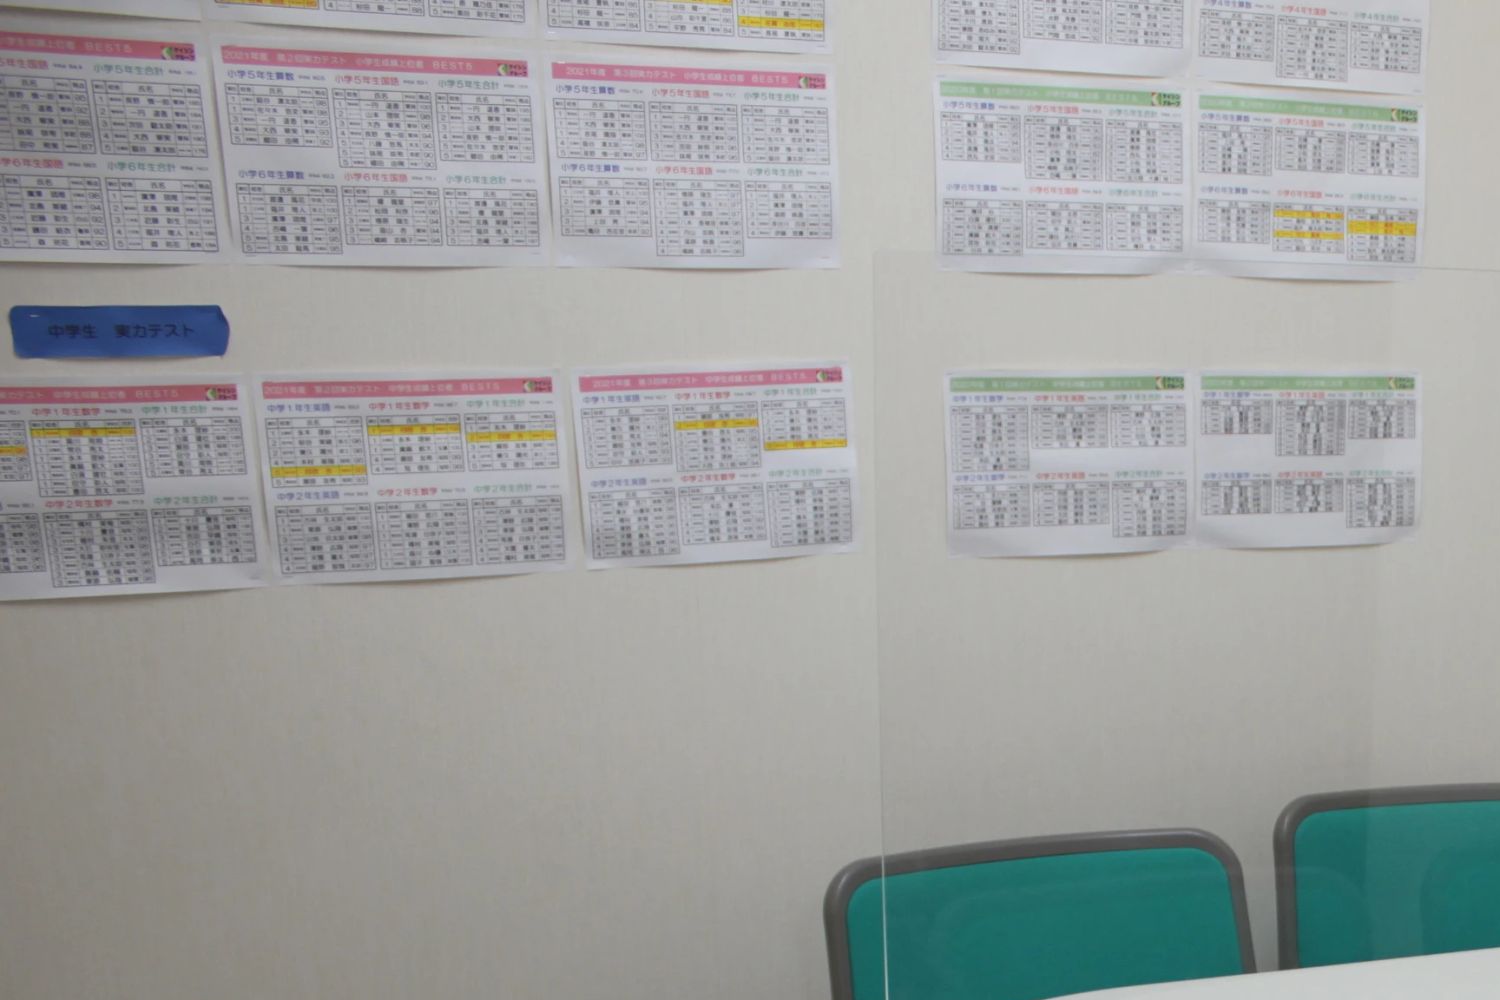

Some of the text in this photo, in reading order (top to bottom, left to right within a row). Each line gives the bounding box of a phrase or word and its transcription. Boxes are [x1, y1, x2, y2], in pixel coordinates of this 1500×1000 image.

[47, 323, 195, 339] 中学生 実力テスト
